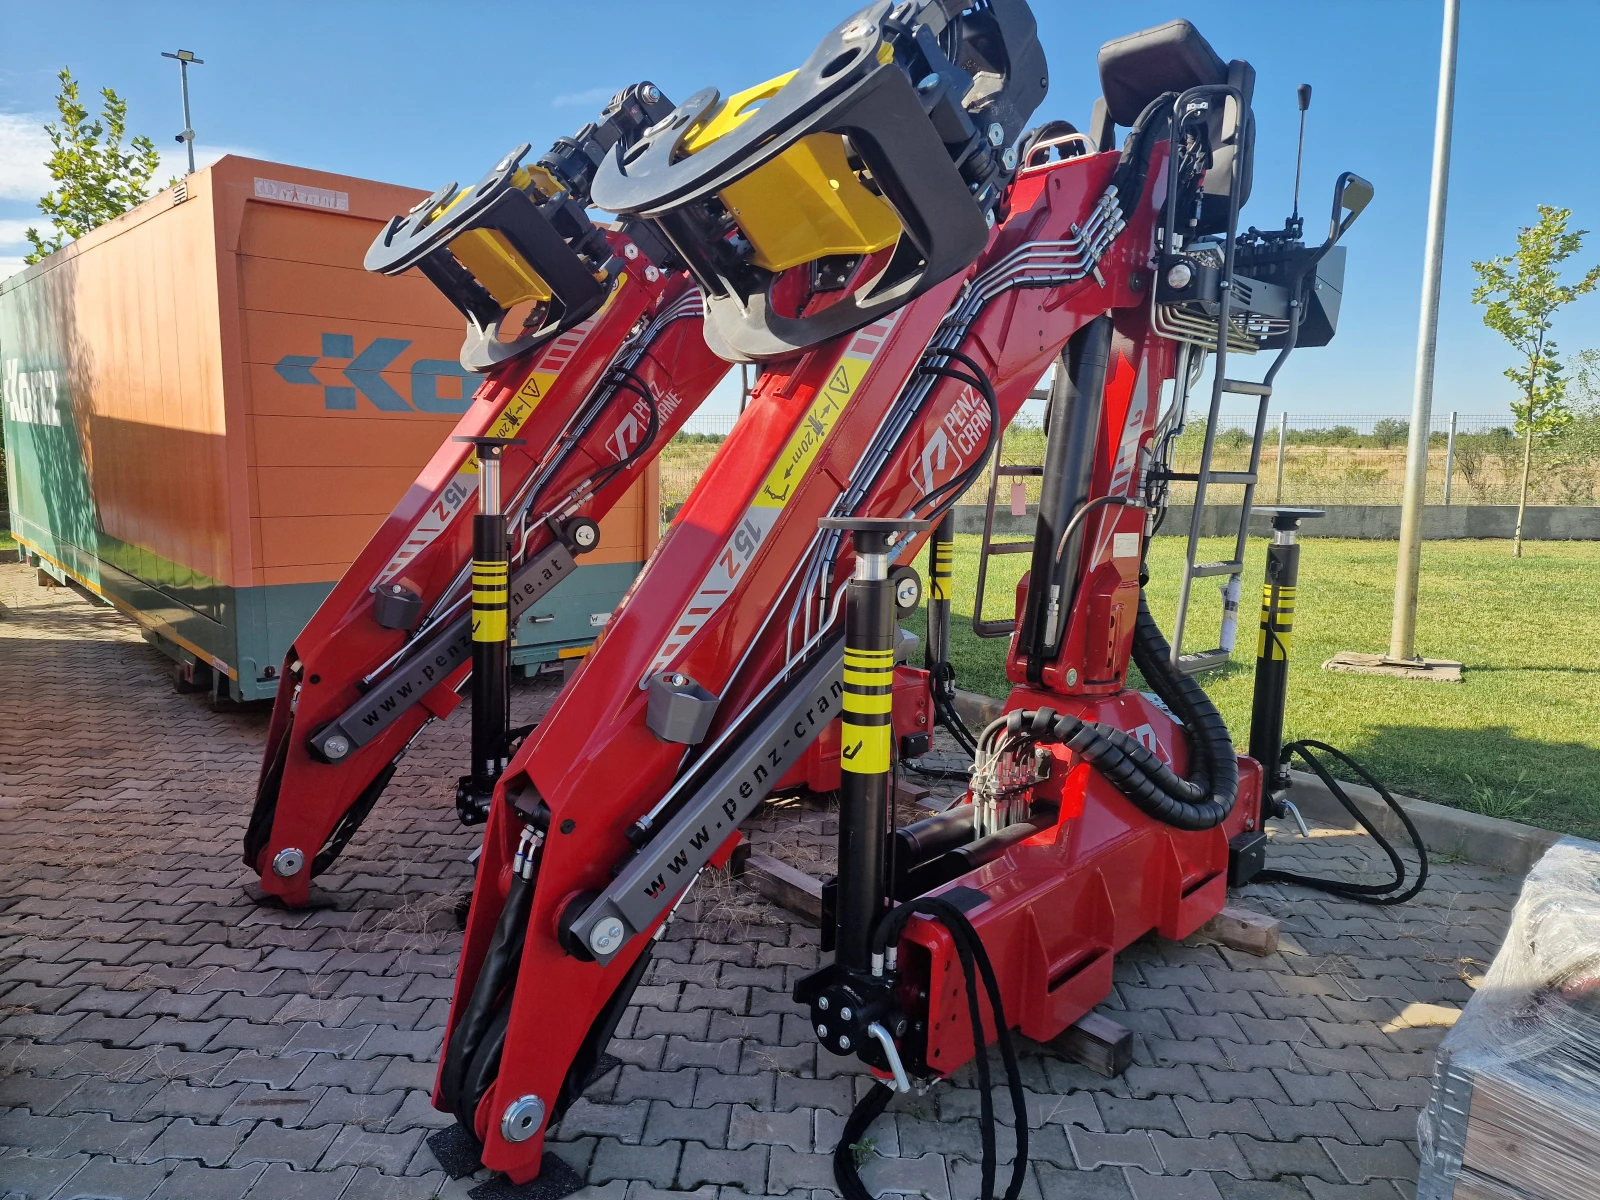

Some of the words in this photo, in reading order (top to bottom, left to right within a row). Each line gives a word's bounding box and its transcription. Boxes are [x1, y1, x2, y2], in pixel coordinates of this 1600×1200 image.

[342, 337, 486, 415] Ko
[496, 422, 510, 438] 20
[943, 384, 980, 437] PENZ
[957, 398, 992, 456] CRAN
[792, 430, 814, 464] 20m
[643, 679, 843, 900] www.penz-cran
